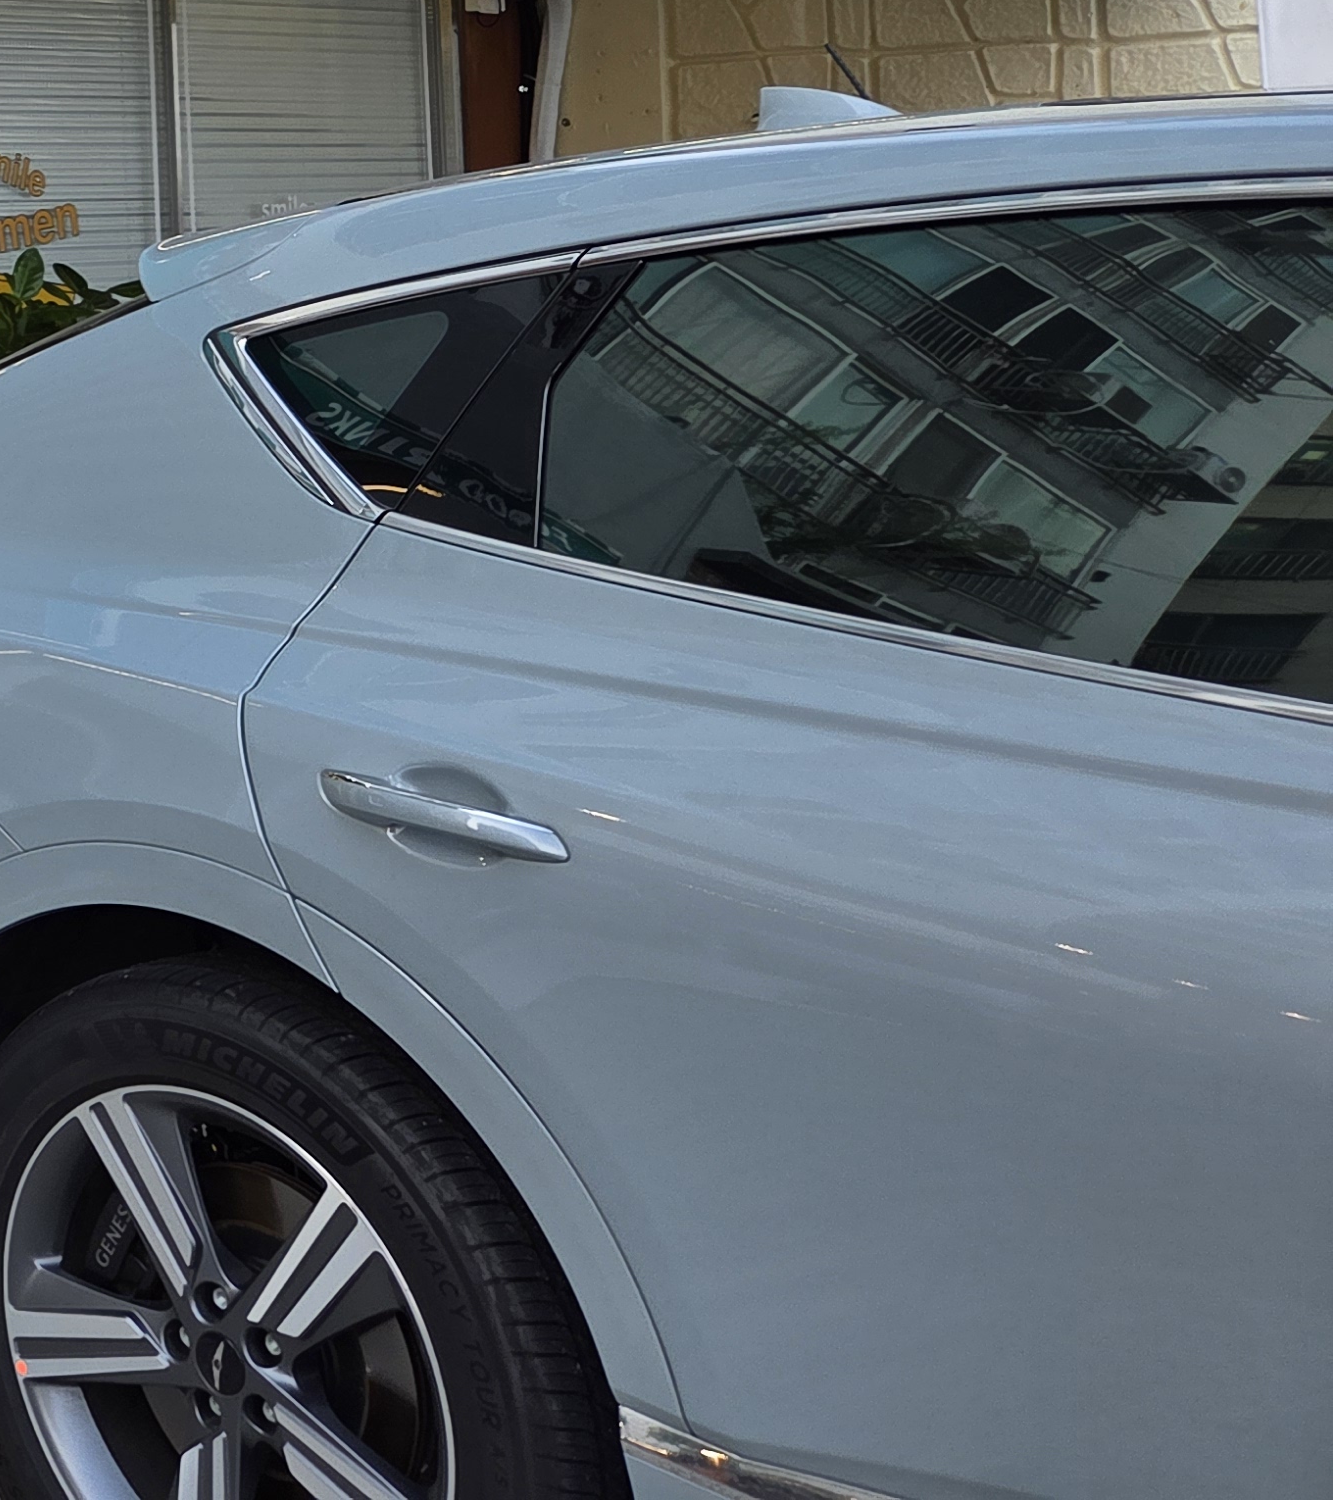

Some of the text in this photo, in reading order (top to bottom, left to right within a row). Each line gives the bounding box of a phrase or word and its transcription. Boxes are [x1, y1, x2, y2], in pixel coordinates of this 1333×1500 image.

[162, 1028, 360, 1158] MICHELIN
[379, 1183, 477, 1325] PRIMACY
[463, 1340, 504, 1438] TOUR
